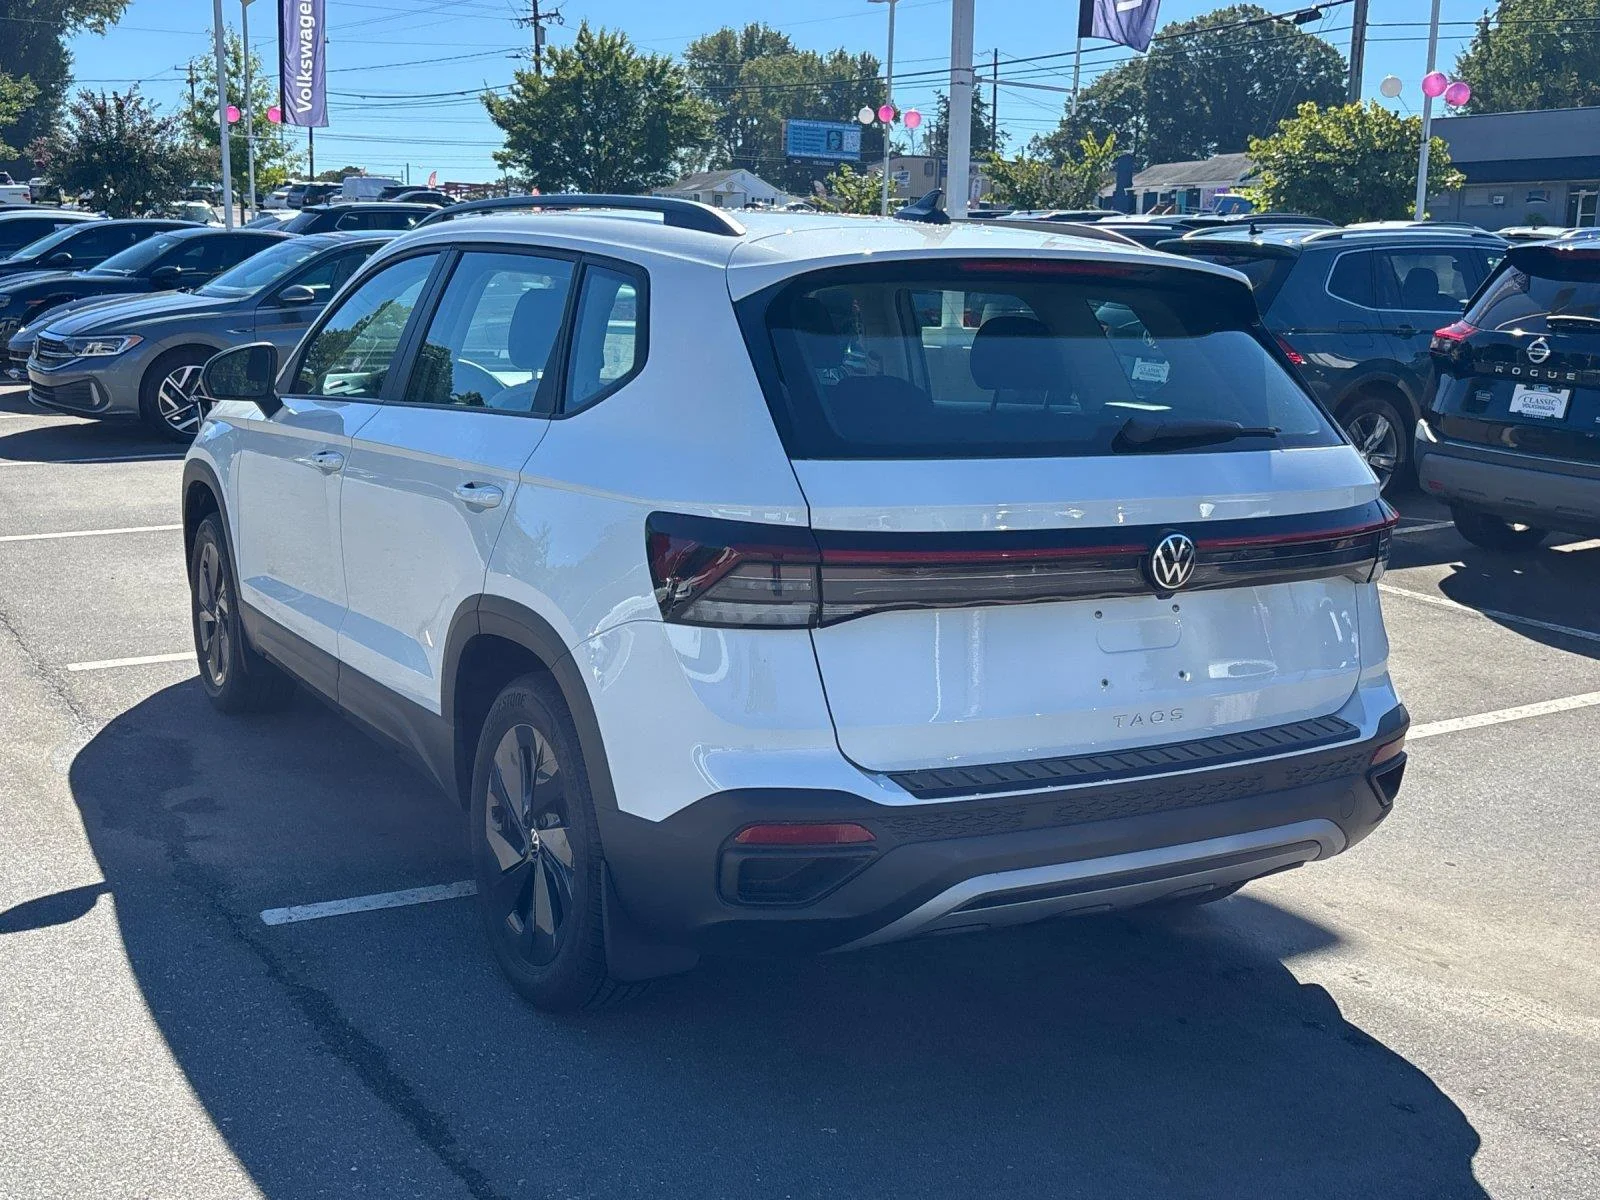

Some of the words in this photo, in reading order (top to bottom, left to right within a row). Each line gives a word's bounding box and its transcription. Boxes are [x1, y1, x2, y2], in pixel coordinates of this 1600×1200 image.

[296, 0, 316, 113] Volkswage
[1495, 365, 1576, 380] ROGUE
[1523, 396, 1558, 406] CLASSIC
[1112, 708, 1184, 728] TAOS
